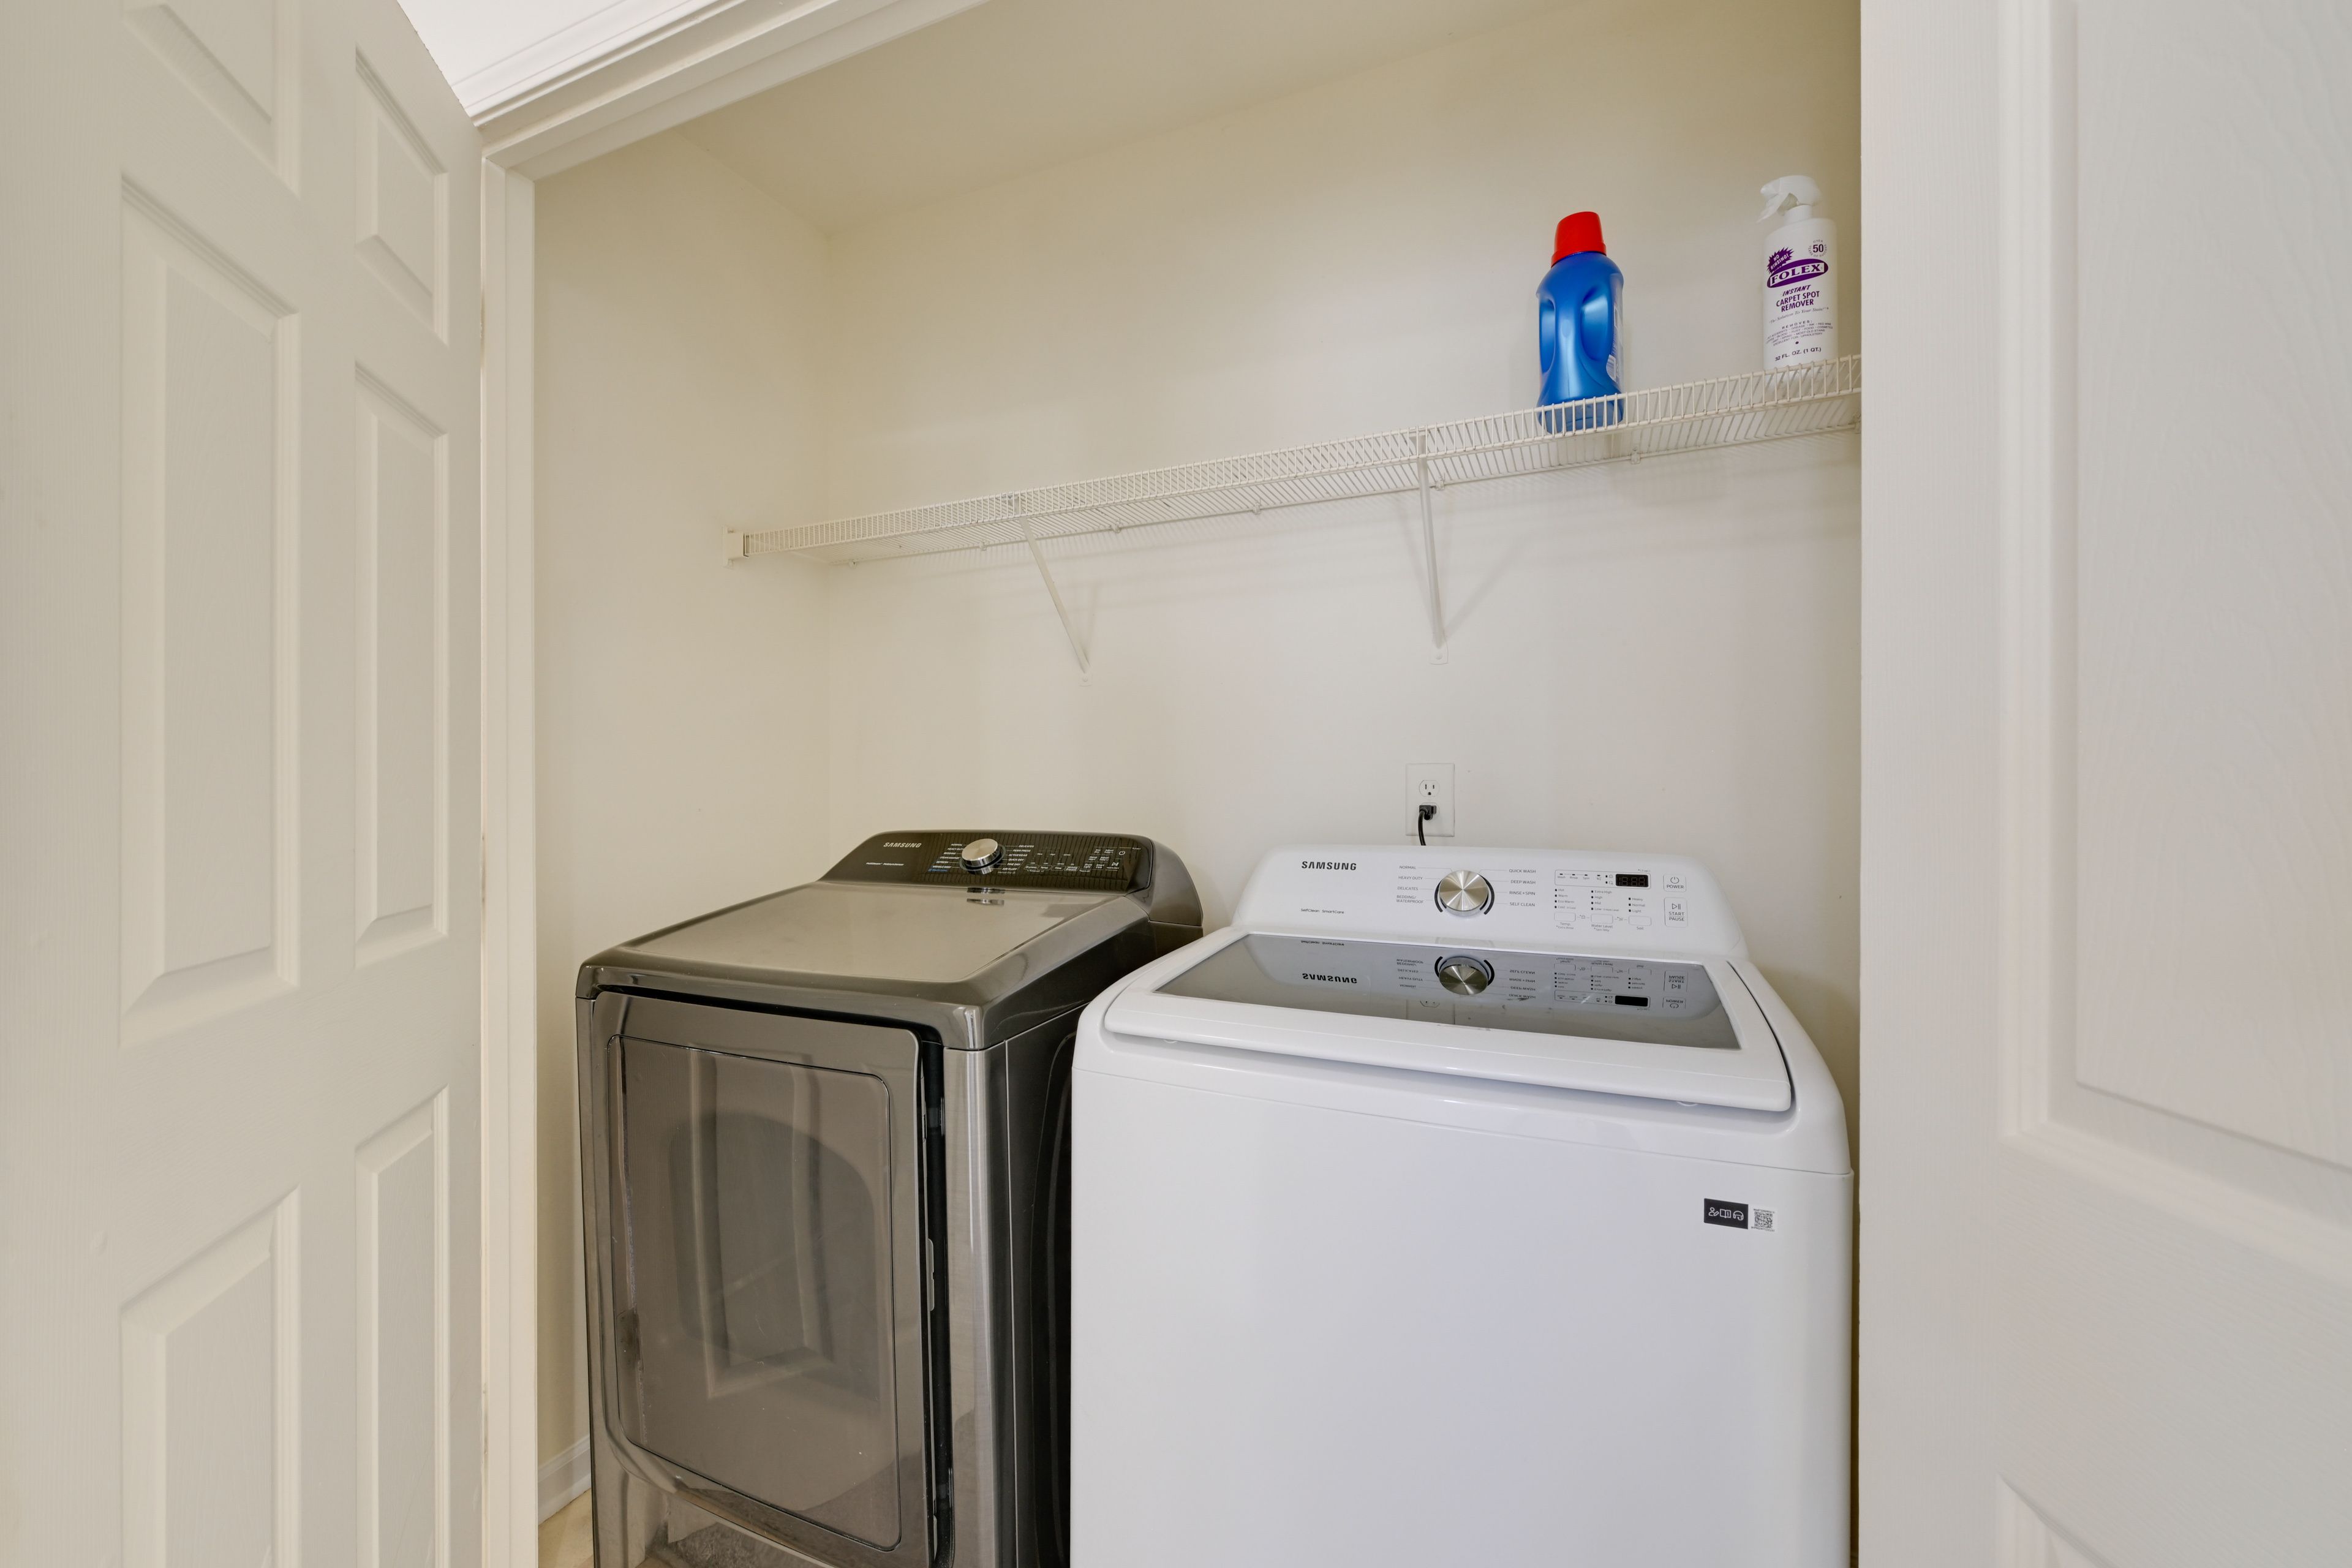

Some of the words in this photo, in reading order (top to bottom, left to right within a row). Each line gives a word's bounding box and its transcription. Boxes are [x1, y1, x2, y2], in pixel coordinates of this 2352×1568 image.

[1813, 244, 1823, 253] 50
[1771, 253, 1789, 270] RINSING!
[1771, 264, 1820, 284] FOLEX
[1782, 284, 1811, 296] INSTANT
[1776, 294, 1800, 307] CARPET
[1781, 299, 1814, 312] REMOVER
[1302, 861, 1357, 870] SAMSUNG
